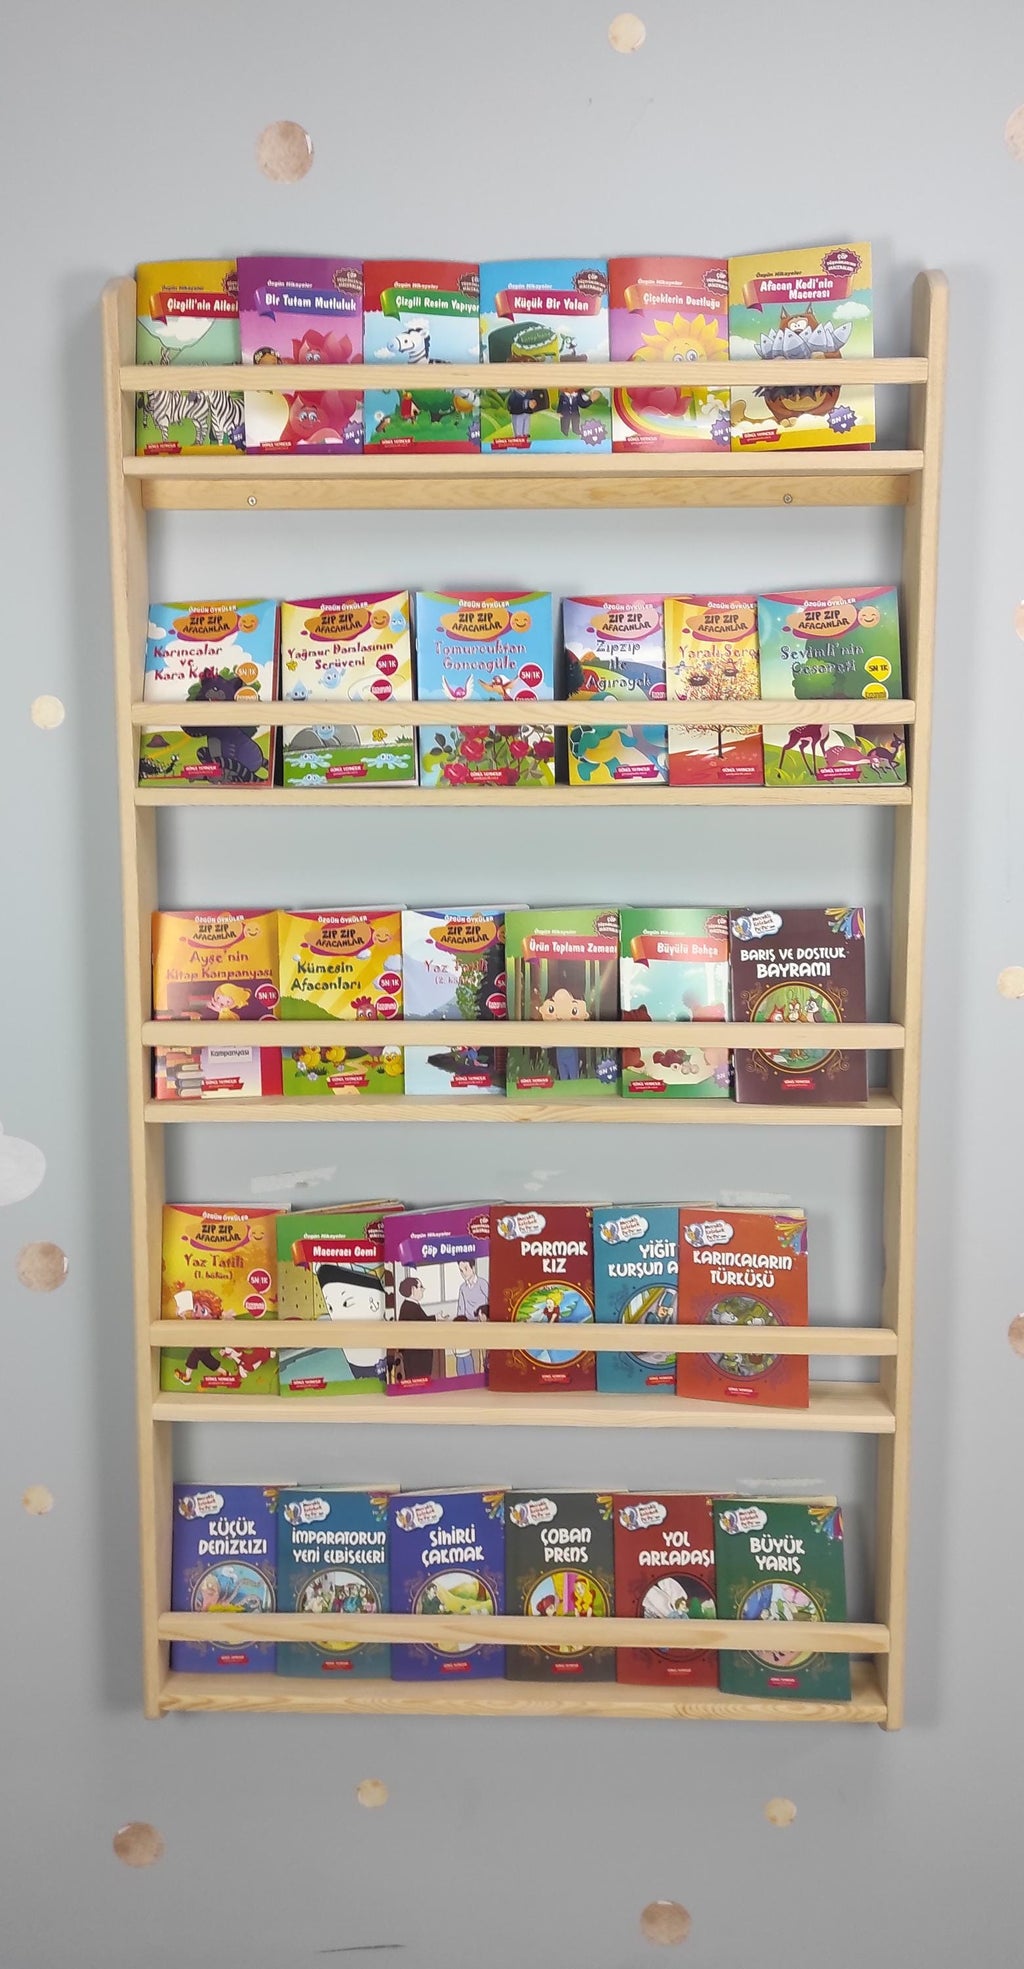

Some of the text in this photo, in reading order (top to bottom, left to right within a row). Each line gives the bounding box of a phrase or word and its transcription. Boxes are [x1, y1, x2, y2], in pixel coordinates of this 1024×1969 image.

[759, 278, 834, 292] Afacan Kedi'nin
[643, 292, 721, 310] Çiçeklerin Dostluğu
[788, 288, 830, 300] Macerası
[166, 297, 211, 313] Çizgili'nin
[265, 293, 357, 311] Bir Tutam Mutluluk
[395, 296, 422, 310] Çizgili
[424, 296, 449, 309] Resim
[514, 295, 589, 312] Küçük Bir Yalan
[320, 602, 341, 611] ÖZGÜN
[458, 599, 480, 609] ÖZGÜN
[730, 602, 757, 610] ÖYKÜLE
[803, 598, 856, 608] ÖZGÜN ÖYKÜLER
[182, 623, 230, 634] AFACANLAR
[314, 620, 363, 634] AFACANLAR
[451, 620, 503, 632] AFACANLAR
[601, 621, 652, 632] AFACANLAR
[698, 622, 748, 633] AFACANLAR
[798, 618, 850, 629] AFACANLAR
[153, 643, 223, 658] Karıncalar
[287, 646, 331, 662] Yağmur
[780, 641, 865, 660] Sevimli'nin
[179, 659, 195, 668] ve
[314, 657, 366, 671] Serüveni
[154, 669, 186, 681] Kara
[192, 931, 237, 940] AFACANLAR
[315, 936, 365, 947] AFACANLAR
[440, 933, 489, 944] AFACANLAR
[529, 939, 618, 954] Ürün Toplama Zamanı
[656, 941, 719, 958] Büyülü Bahçe
[740, 946, 847, 962] BARIŞ VE DOSTLUK
[189, 948, 249, 965] Ayşe'nin
[166, 966, 273, 981] Kitap Kampanyası
[296, 960, 354, 975] Kümesin
[756, 962, 831, 979] BAYRAMI
[290, 976, 362, 991] Afacanları
[195, 1232, 241, 1242] AFACANLAR
[312, 1246, 377, 1257] Maceracı Gemi
[421, 1243, 476, 1258] Çöp Düşmanı
[520, 1240, 589, 1256] PARMAK
[639, 1239, 677, 1259] YİĞİT
[184, 1253, 245, 1268] Yaz Tatili
[542, 1258, 566, 1273] KIZ
[693, 1250, 793, 1271] KARINCALARIN
[608, 1261, 663, 1278] KURŞUN
[709, 1267, 775, 1288] TÜRKÜSÜ
[208, 1517, 257, 1539] KÜÇÜK
[429, 1523, 476, 1547] SİHİRLİ
[291, 1527, 386, 1546] İMPARATORUN
[540, 1527, 592, 1545] ÇOBAN
[662, 1531, 690, 1547] YOL
[198, 1536, 267, 1556] DENİZKIZI
[749, 1533, 806, 1555] BÜYÜK
[292, 1547, 385, 1565] YENİ ELBİSELERİ
[421, 1545, 485, 1568] ÇAKMAK
[544, 1546, 589, 1563] PRENS
[638, 1550, 715, 1567] ARKADAŞI
[755, 1555, 802, 1575] YARIŞ
